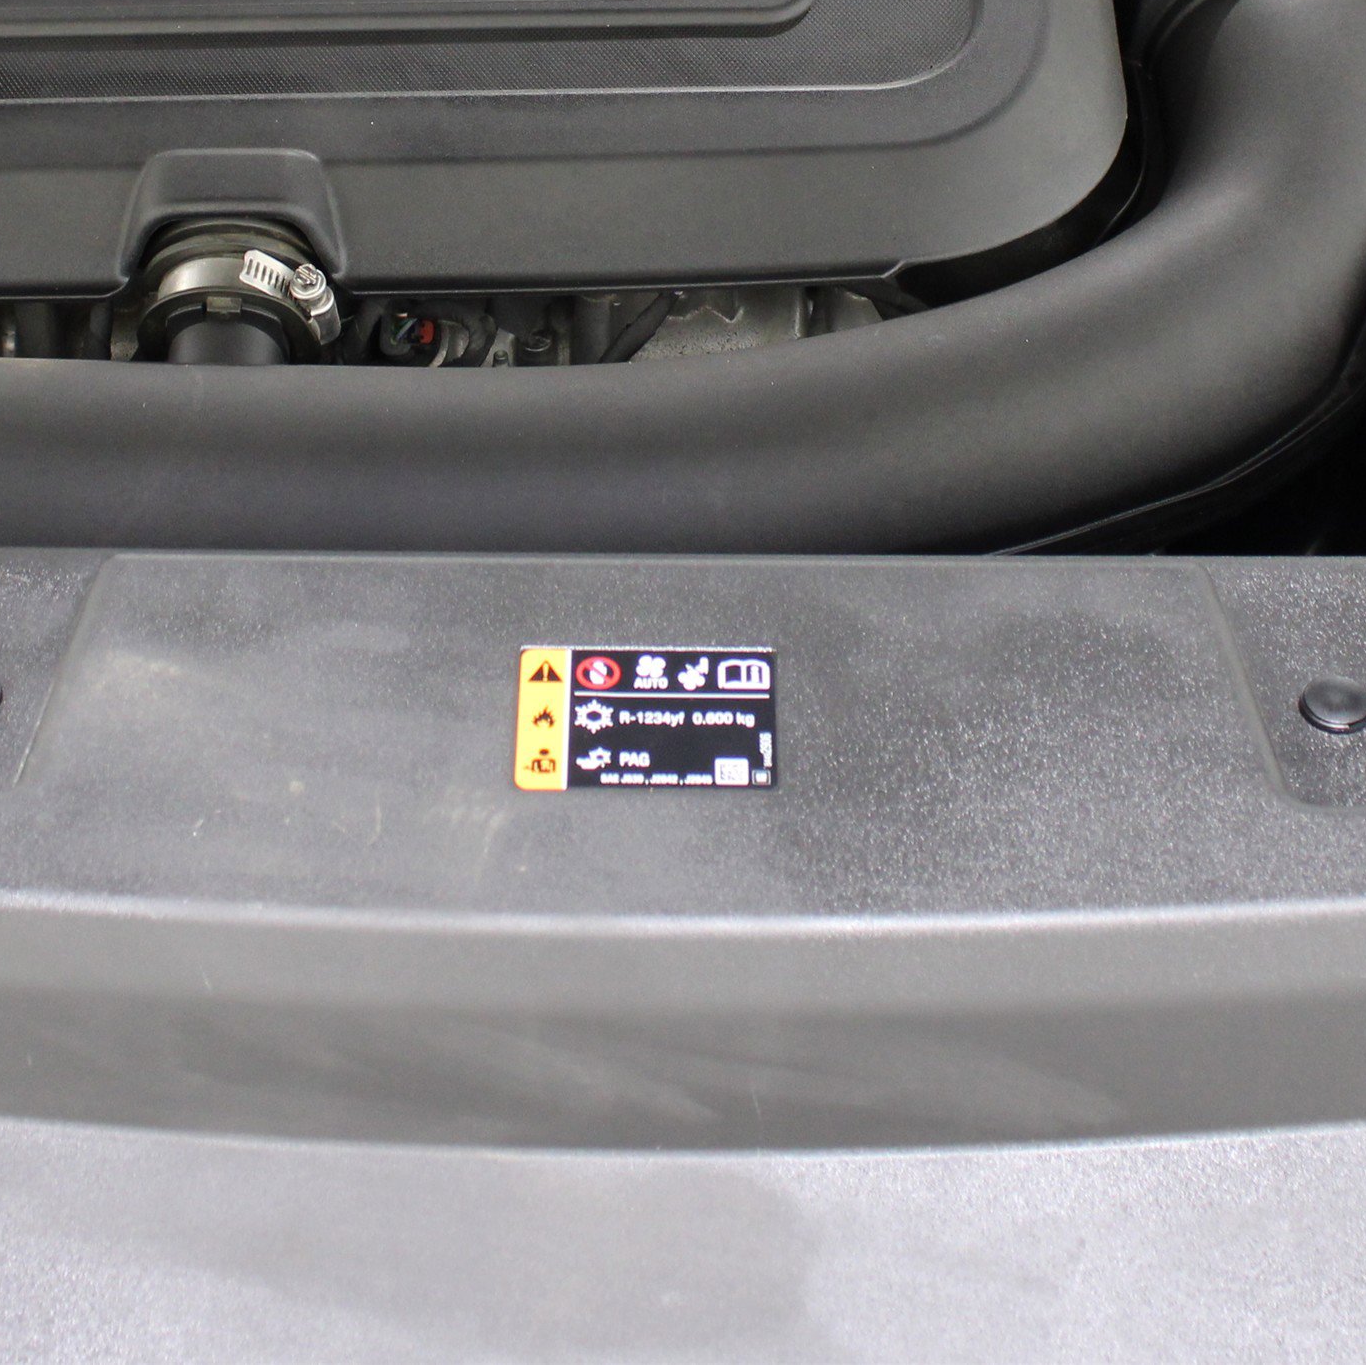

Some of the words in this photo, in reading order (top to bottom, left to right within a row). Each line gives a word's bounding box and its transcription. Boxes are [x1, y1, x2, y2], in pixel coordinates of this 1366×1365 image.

[633, 676, 669, 690] AUTO
[618, 711, 685, 728] R-1234yf
[736, 711, 756, 728] kg
[618, 751, 651, 768] PAG
